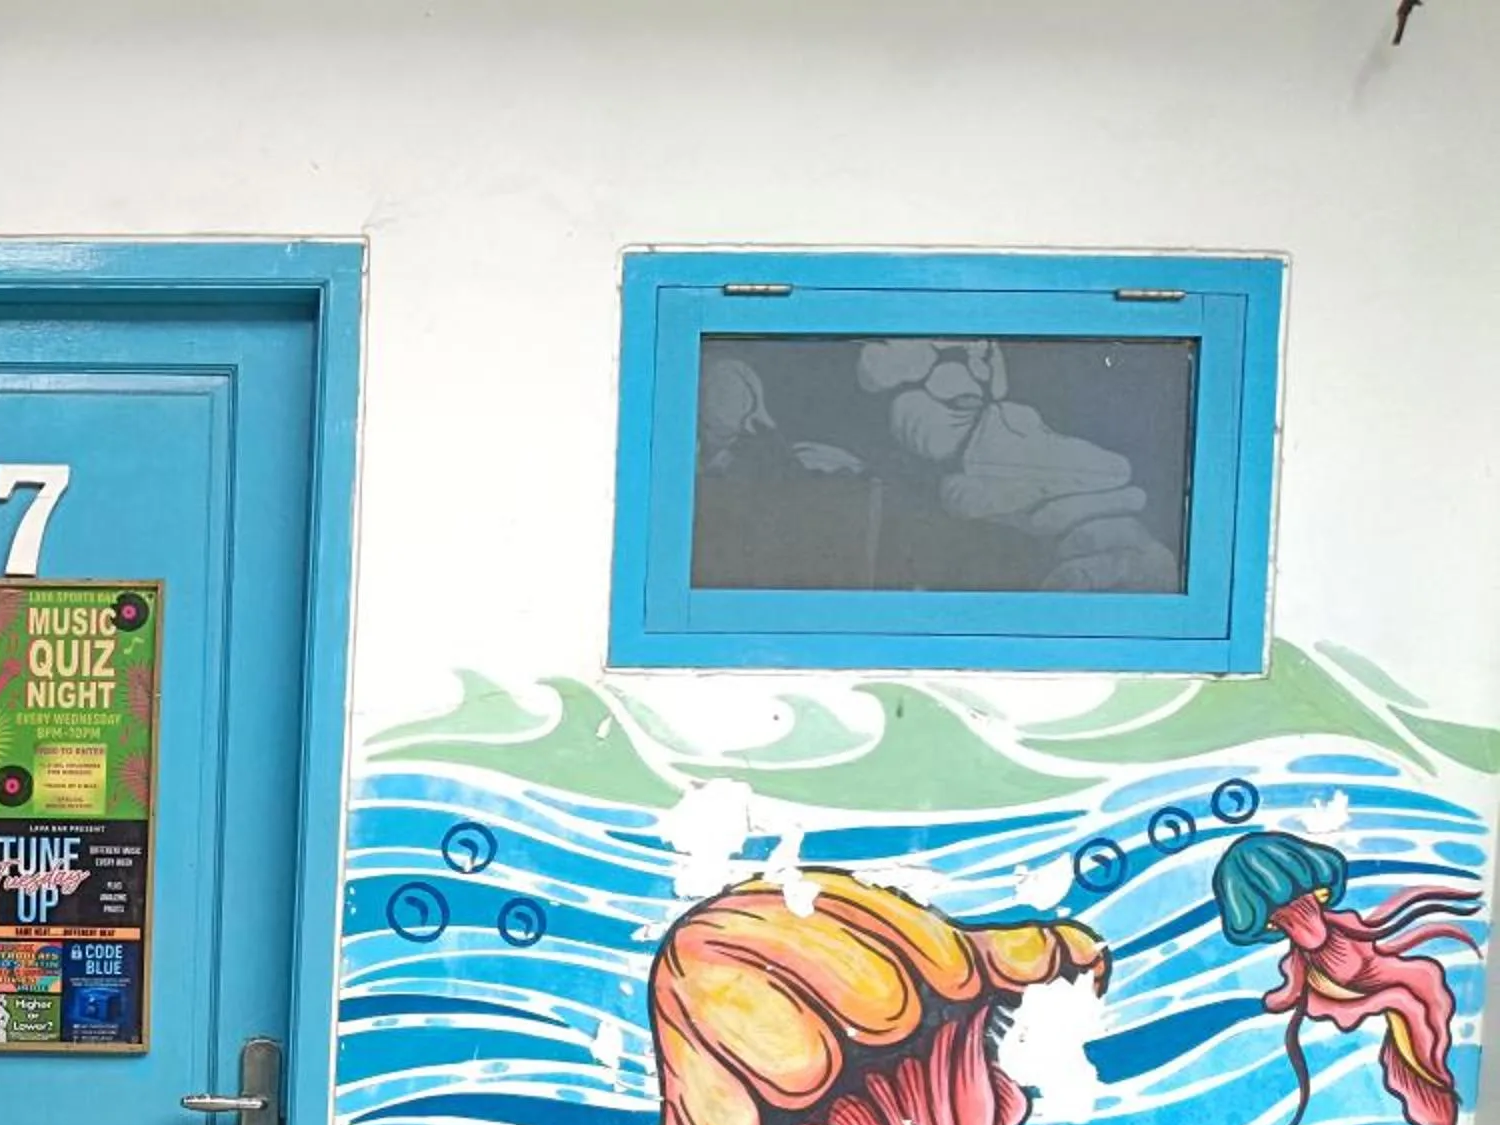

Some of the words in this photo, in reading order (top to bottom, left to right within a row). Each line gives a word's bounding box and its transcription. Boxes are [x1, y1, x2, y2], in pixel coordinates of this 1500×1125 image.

[28, 607, 116, 636] MUSIC
[28, 638, 116, 680] QUIZ
[27, 681, 116, 709] NIGHT
[16, 713, 52, 726] EVERY
[53, 713, 121, 726] WEDNESDAY
[29, 825, 50, 833] LAVA
[51, 825, 68, 833] BAR
[17, 882, 59, 923] UP
[85, 944, 123, 959] CODE
[85, 960, 122, 975] BLUE
[15, 999, 53, 1011] Higher
[13, 1021, 54, 1031] Lower?
